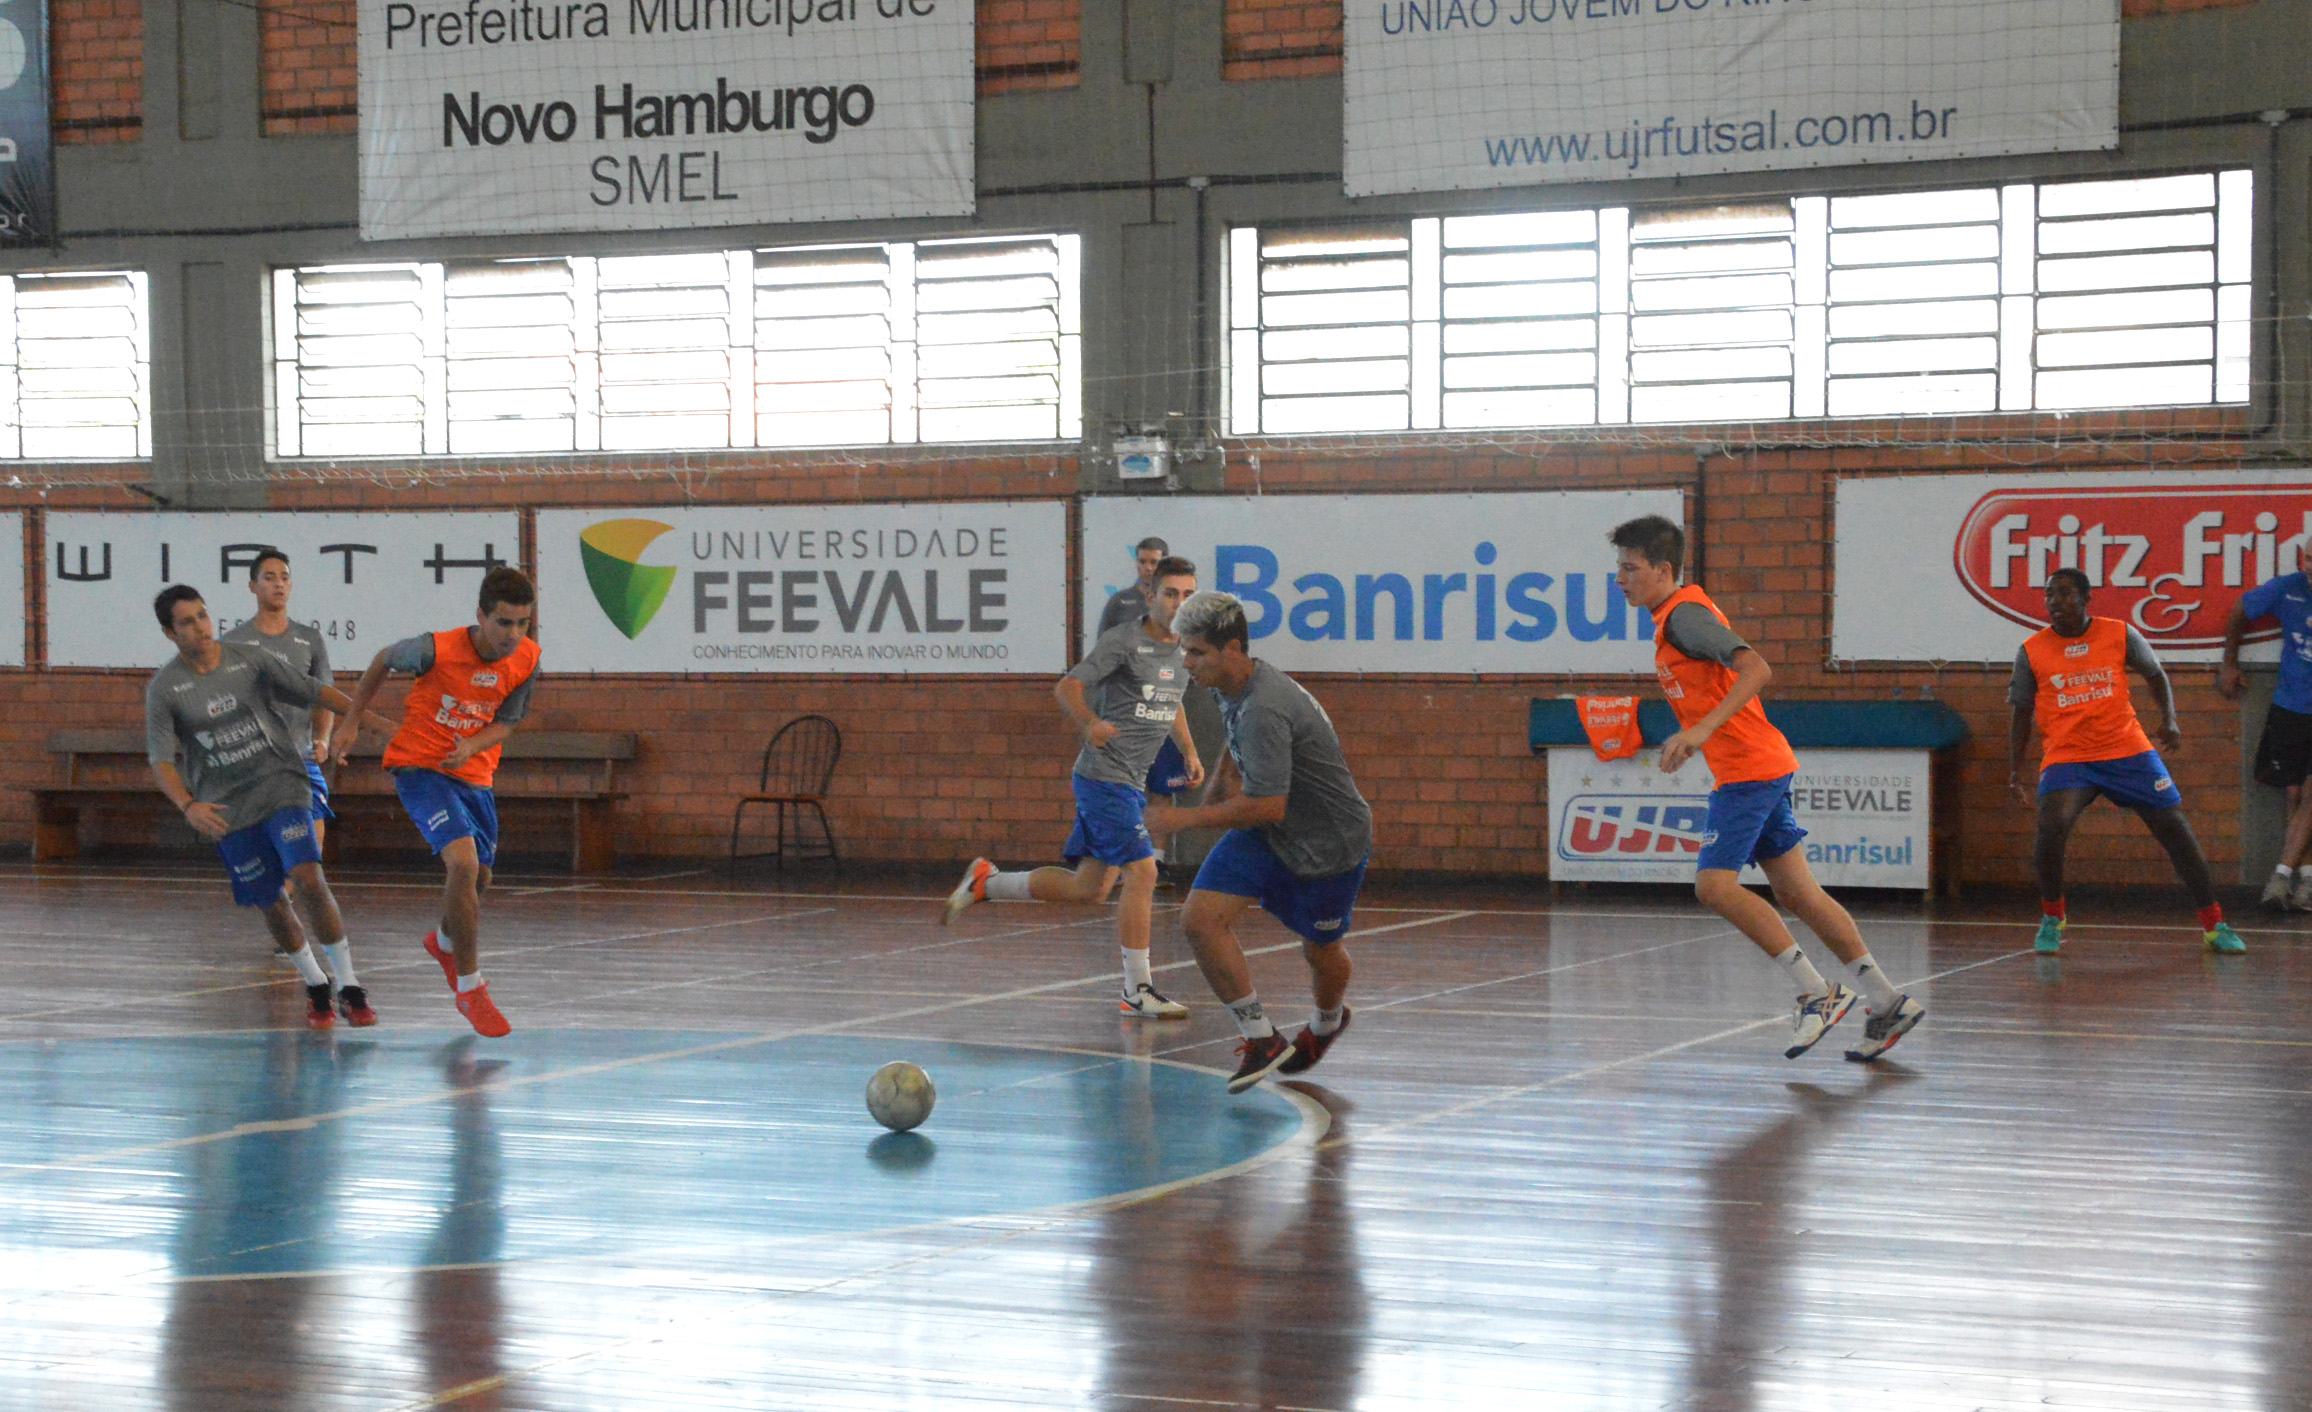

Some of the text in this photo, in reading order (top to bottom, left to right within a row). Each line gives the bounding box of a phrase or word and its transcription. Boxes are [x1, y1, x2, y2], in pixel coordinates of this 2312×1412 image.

[387, 0, 609, 49] Prefeitura
[443, 77, 874, 148] Novo Hamburgo
[1485, 100, 1957, 169] www.ujrfutsal.com.br
[590, 151, 738, 207] SMEL
[693, 528, 1008, 560] UNIVERSIDADE
[1990, 513, 2150, 588] Fritz
[693, 568, 1009, 634] FEEVALE
[693, 644, 1009, 660] CONHECIMENTO PARA INOVAR O MUNDO
[2057, 684, 2114, 708] Banrisul
[1793, 775, 1912, 788] UNIVERSIDADE
[1793, 788, 1912, 812] FEEVALE
[1571, 806, 1708, 853] UJR
[1801, 836, 1912, 865] anrisul
